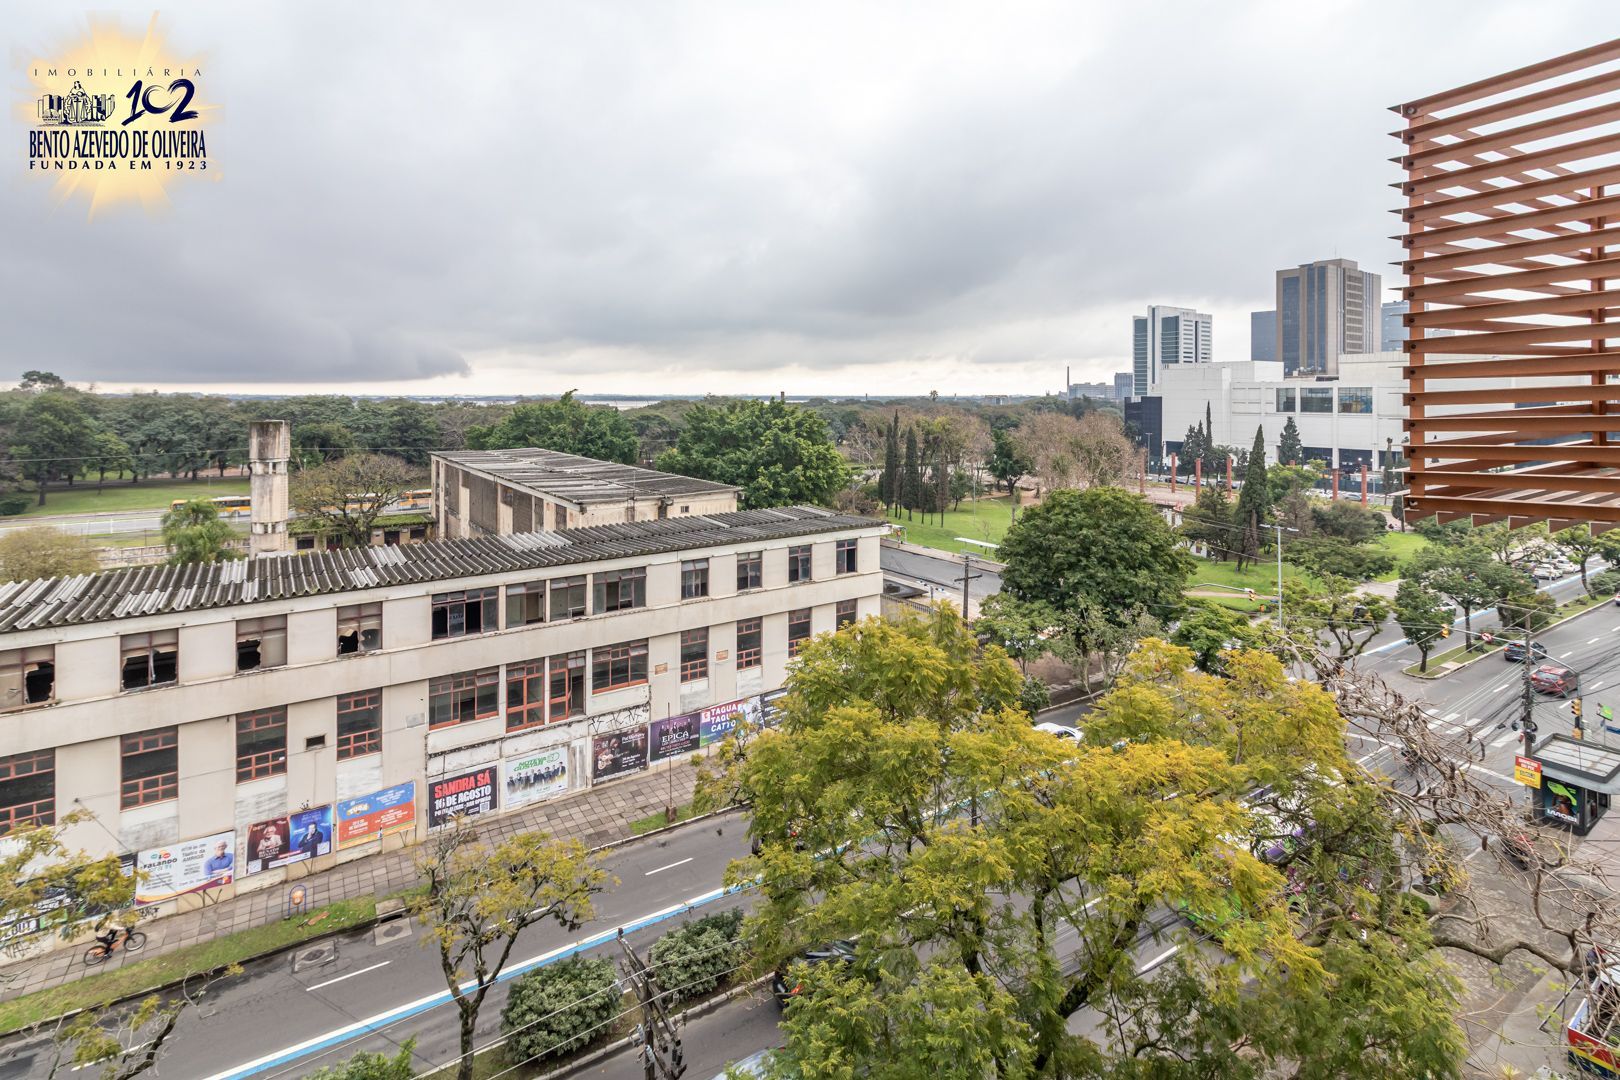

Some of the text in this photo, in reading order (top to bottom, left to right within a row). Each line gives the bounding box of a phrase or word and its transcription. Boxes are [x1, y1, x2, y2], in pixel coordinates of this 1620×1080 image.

[662, 730, 689, 742] EPICA
[434, 769, 491, 798] SANDRA SÁ
[446, 794, 457, 807] DE
[458, 785, 492, 804] AGOSTO
